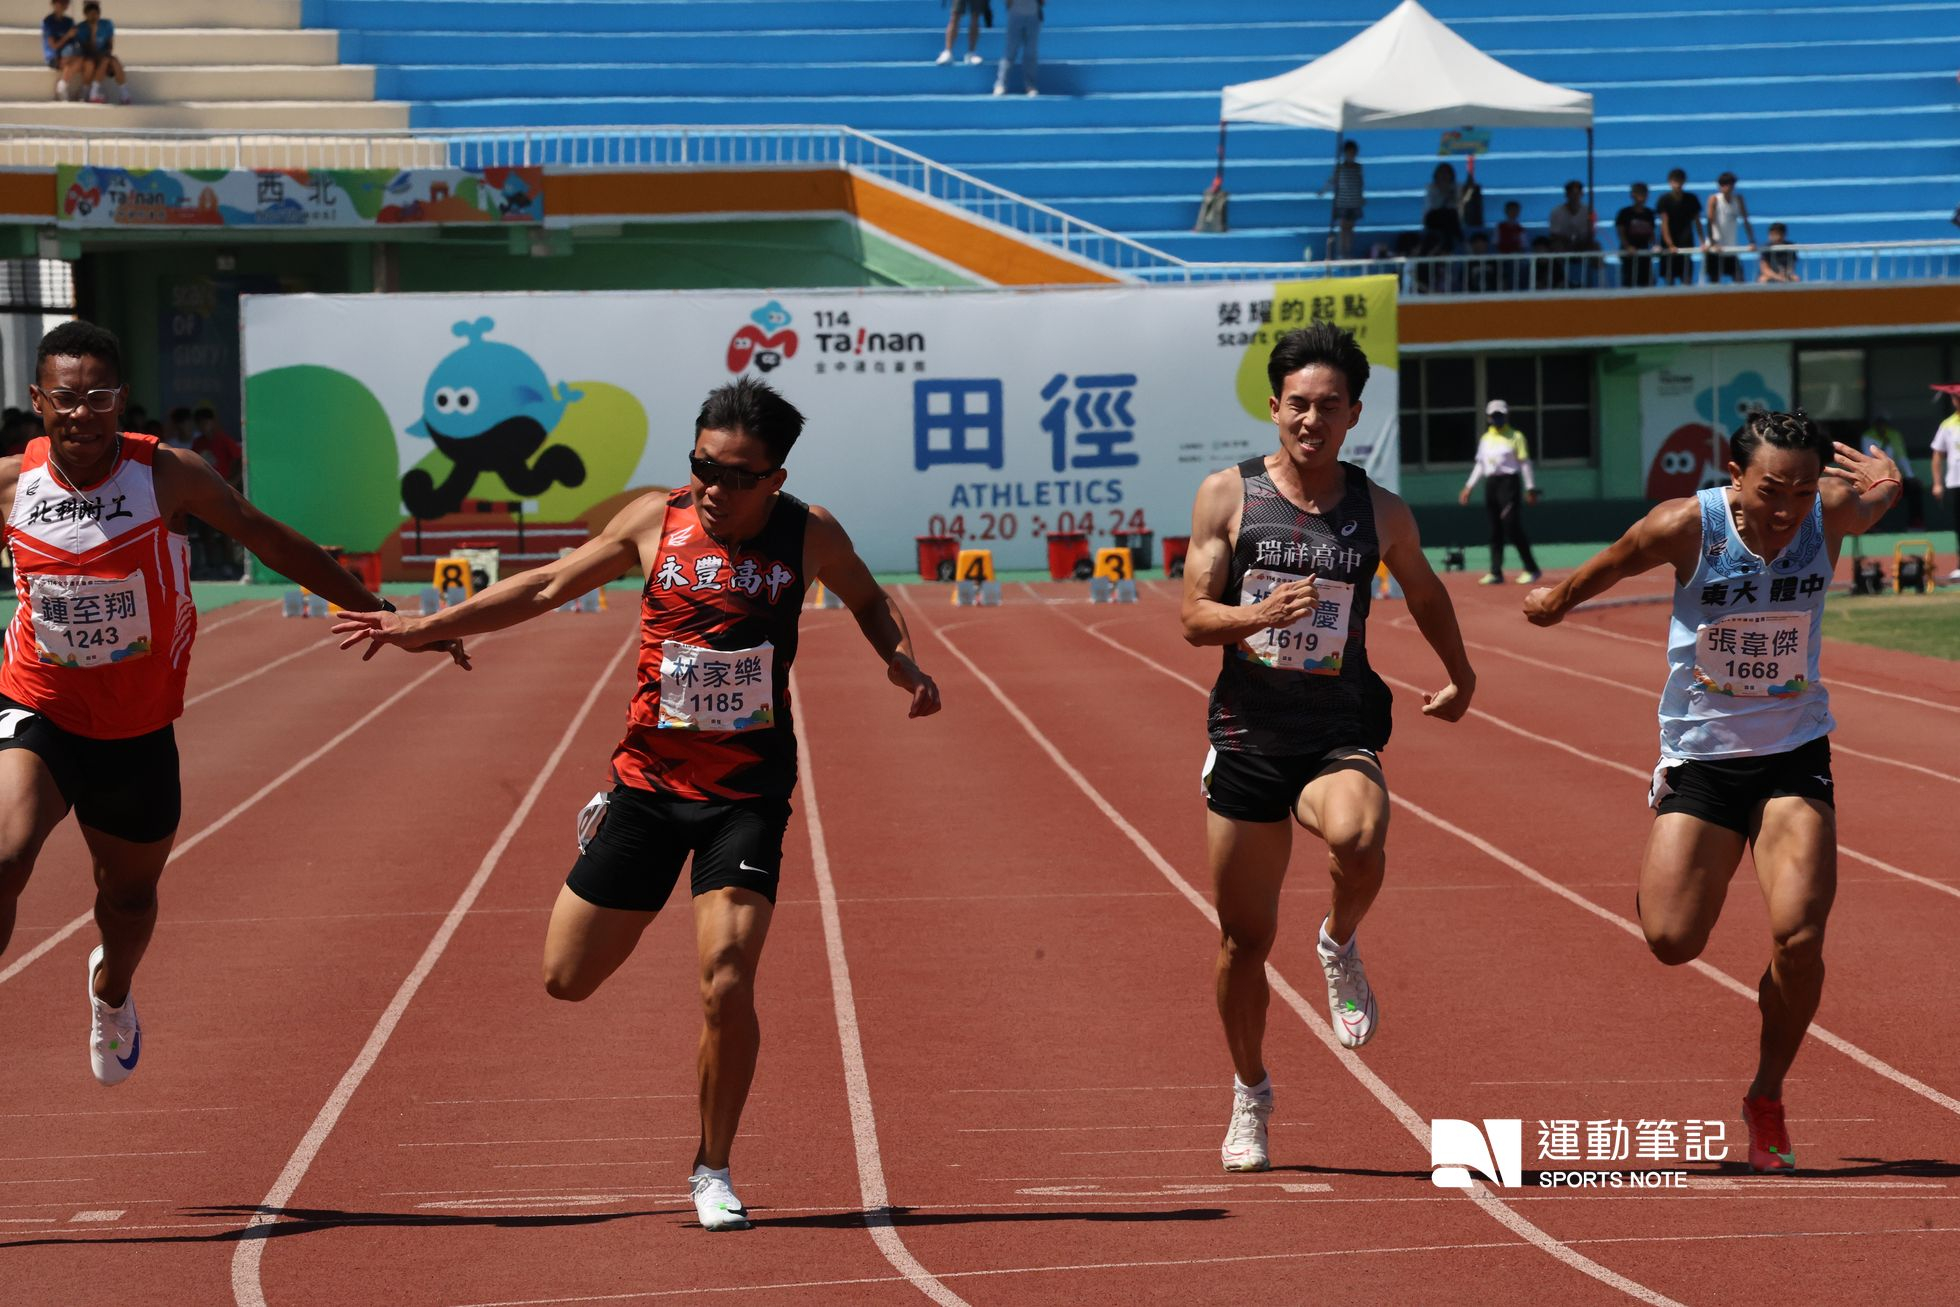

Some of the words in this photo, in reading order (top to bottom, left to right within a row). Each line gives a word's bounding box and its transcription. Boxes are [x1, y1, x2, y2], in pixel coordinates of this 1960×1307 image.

[257, 173, 337, 205] 西北
[814, 310, 850, 328] 114
[1218, 293, 1367, 326] 榮耀的起點
[913, 373, 1139, 473] 田徑
[950, 479, 1123, 508] ATHLETICS
[28, 495, 133, 525] 北科附工
[929, 512, 1017, 541] 04.20
[965, 556, 987, 583] 4
[1104, 554, 1125, 581] 3
[1256, 540, 1362, 573] 瑞祥高中
[442, 564, 463, 592] 8
[656, 555, 793, 601] 永豐高中
[1701, 573, 1824, 607] 東大體中
[63, 627, 119, 649] 1243
[1266, 628, 1318, 651] 1619
[1708, 627, 1798, 657] 張韋傑
[673, 656, 762, 688] 林家樂
[1725, 660, 1779, 679] 1668
[690, 693, 744, 713] 1185
